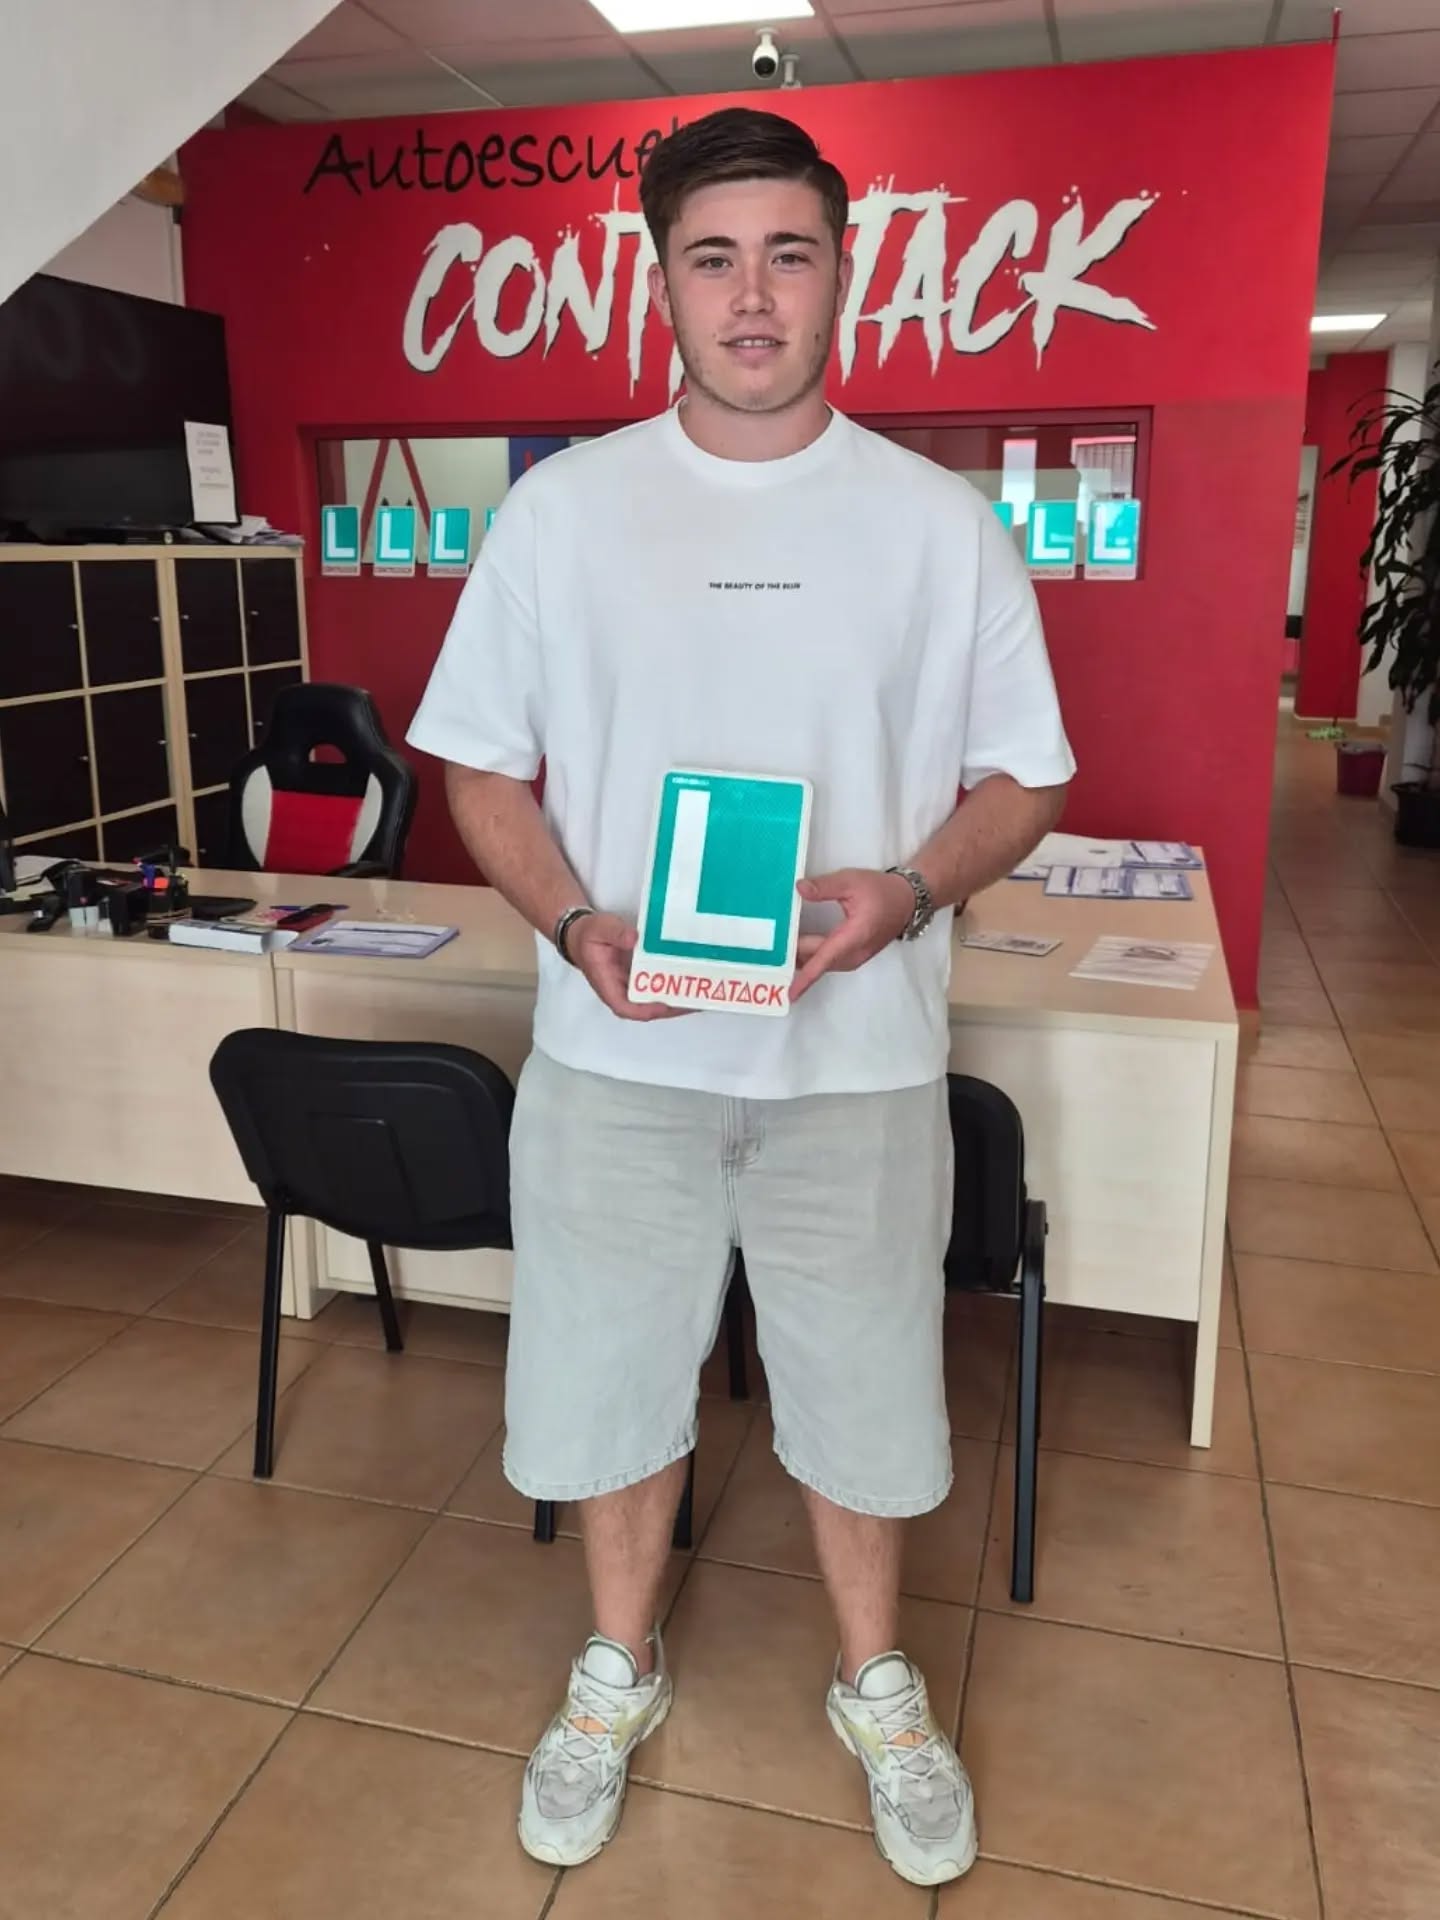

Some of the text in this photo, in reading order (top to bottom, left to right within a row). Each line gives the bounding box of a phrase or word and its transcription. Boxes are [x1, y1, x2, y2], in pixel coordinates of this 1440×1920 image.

[303, 115, 678, 195] Autoescue
[326, 511, 356, 558] L
[379, 511, 411, 559] L
[434, 511, 465, 560] L
[1032, 507, 1070, 560] L
[660, 788, 776, 951] L
[634, 971, 785, 1006] CONTRATACK
